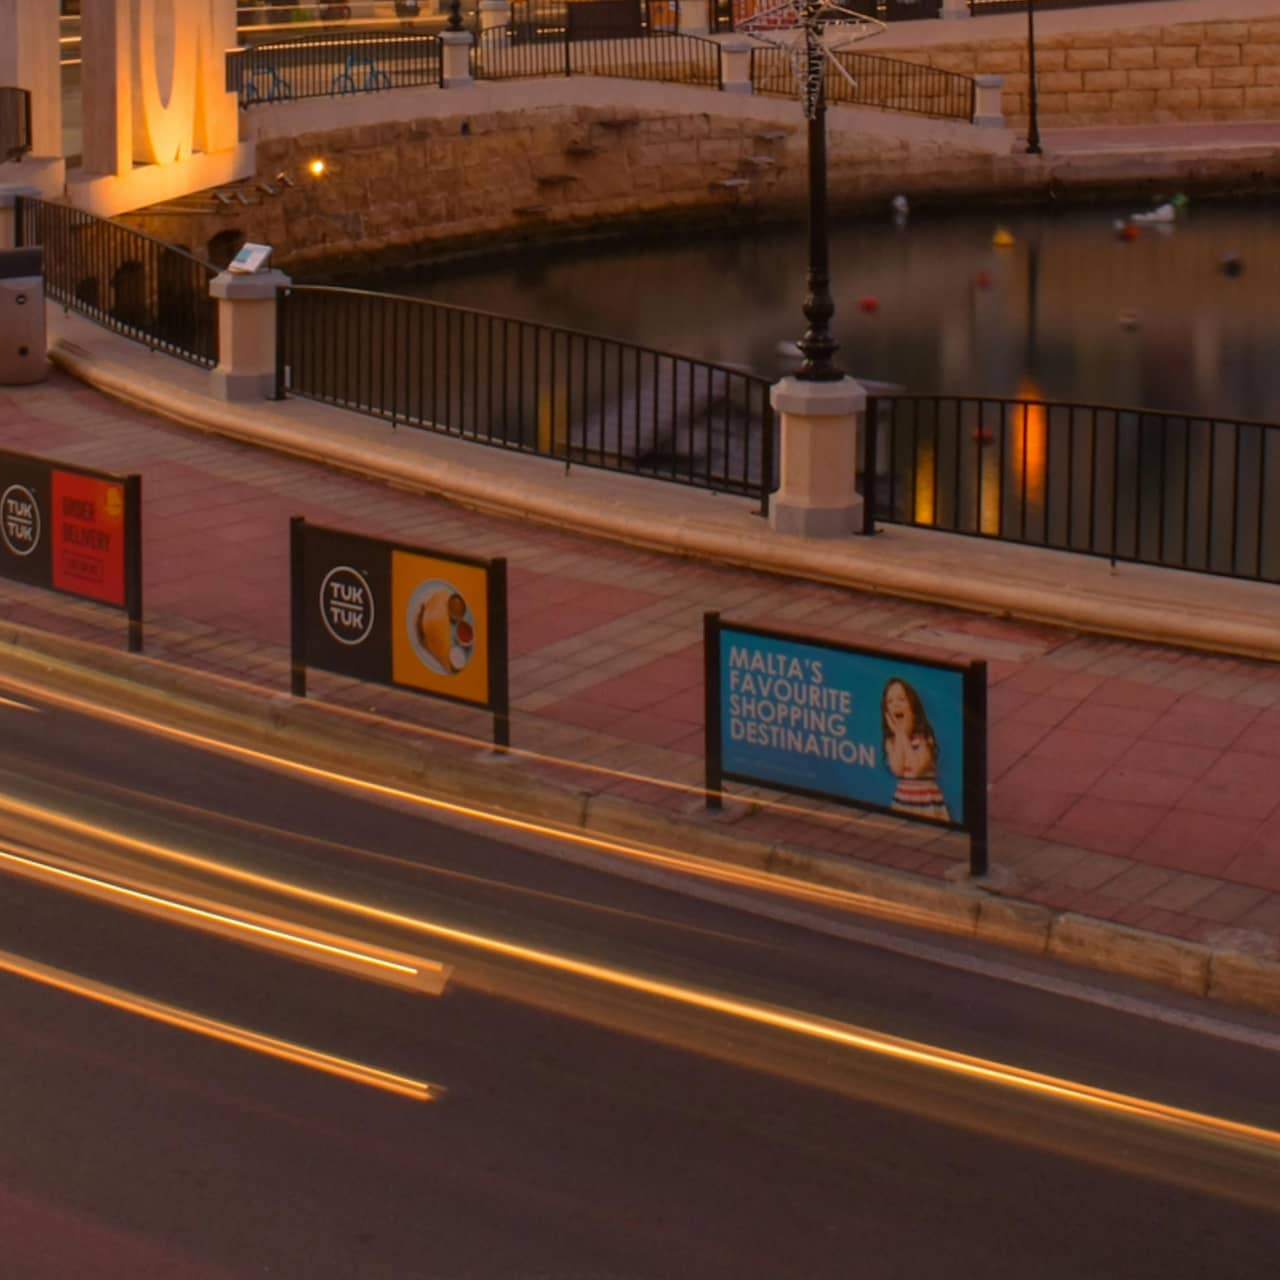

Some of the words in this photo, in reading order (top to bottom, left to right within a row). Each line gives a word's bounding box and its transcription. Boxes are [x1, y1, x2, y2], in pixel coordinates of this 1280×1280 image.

[7, 499, 32, 519] TUK
[7, 521, 32, 541] TUK
[330, 581, 363, 604] TUK
[330, 607, 363, 629] TUK
[729, 645, 823, 684] MALTA'S
[729, 670, 851, 714] FAVOURITE
[729, 693, 847, 737] SHOPPING
[730, 717, 876, 768] DESTINATION
